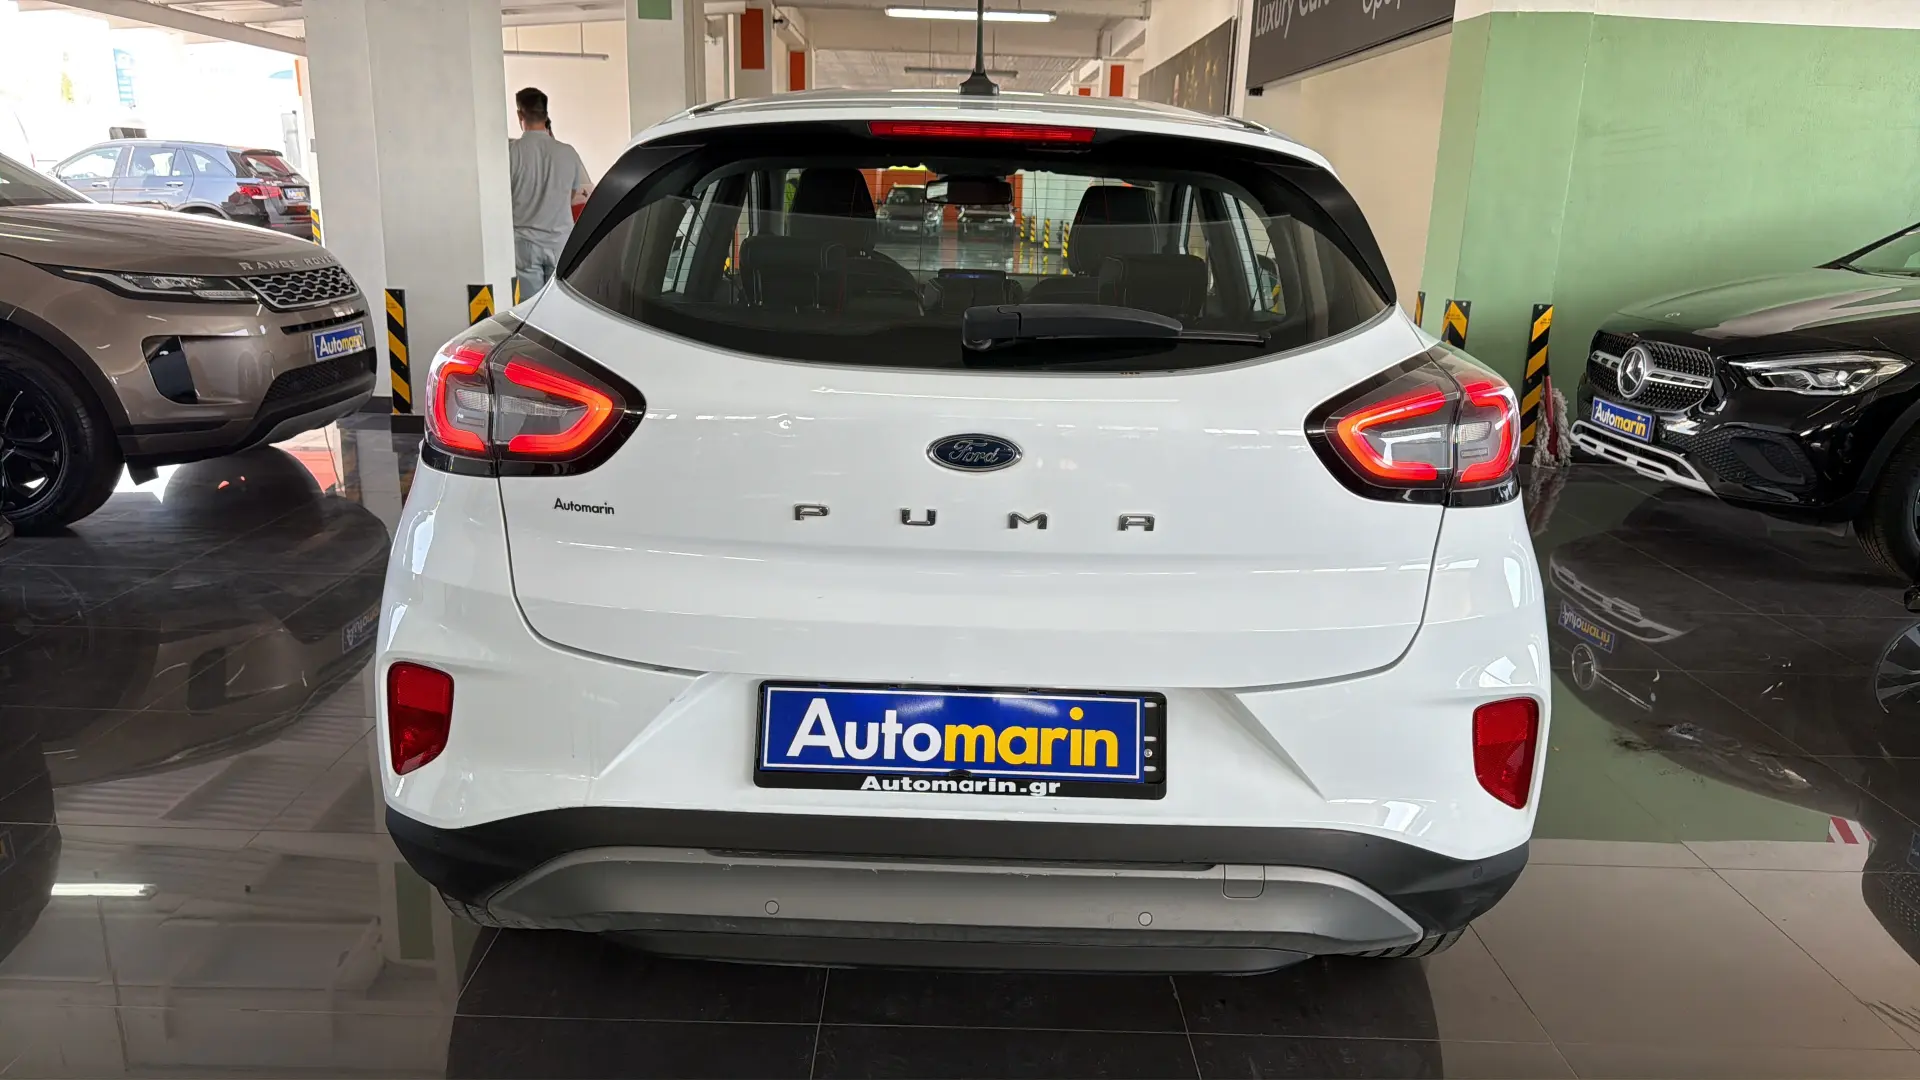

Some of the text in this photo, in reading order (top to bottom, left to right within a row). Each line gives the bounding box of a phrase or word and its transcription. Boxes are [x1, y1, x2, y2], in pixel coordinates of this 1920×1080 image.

[1255, 0, 1296, 39] Luxury
[239, 255, 336, 271] RANGE ROVE
[320, 329, 363, 357] Automarin
[1594, 402, 1647, 437] Automarin
[949, 440, 1000, 463] Ford
[554, 497, 615, 515] Automarin
[794, 503, 1155, 532] PUMA
[786, 697, 1119, 768] Automarin
[860, 775, 1060, 797] Automarin.gr
